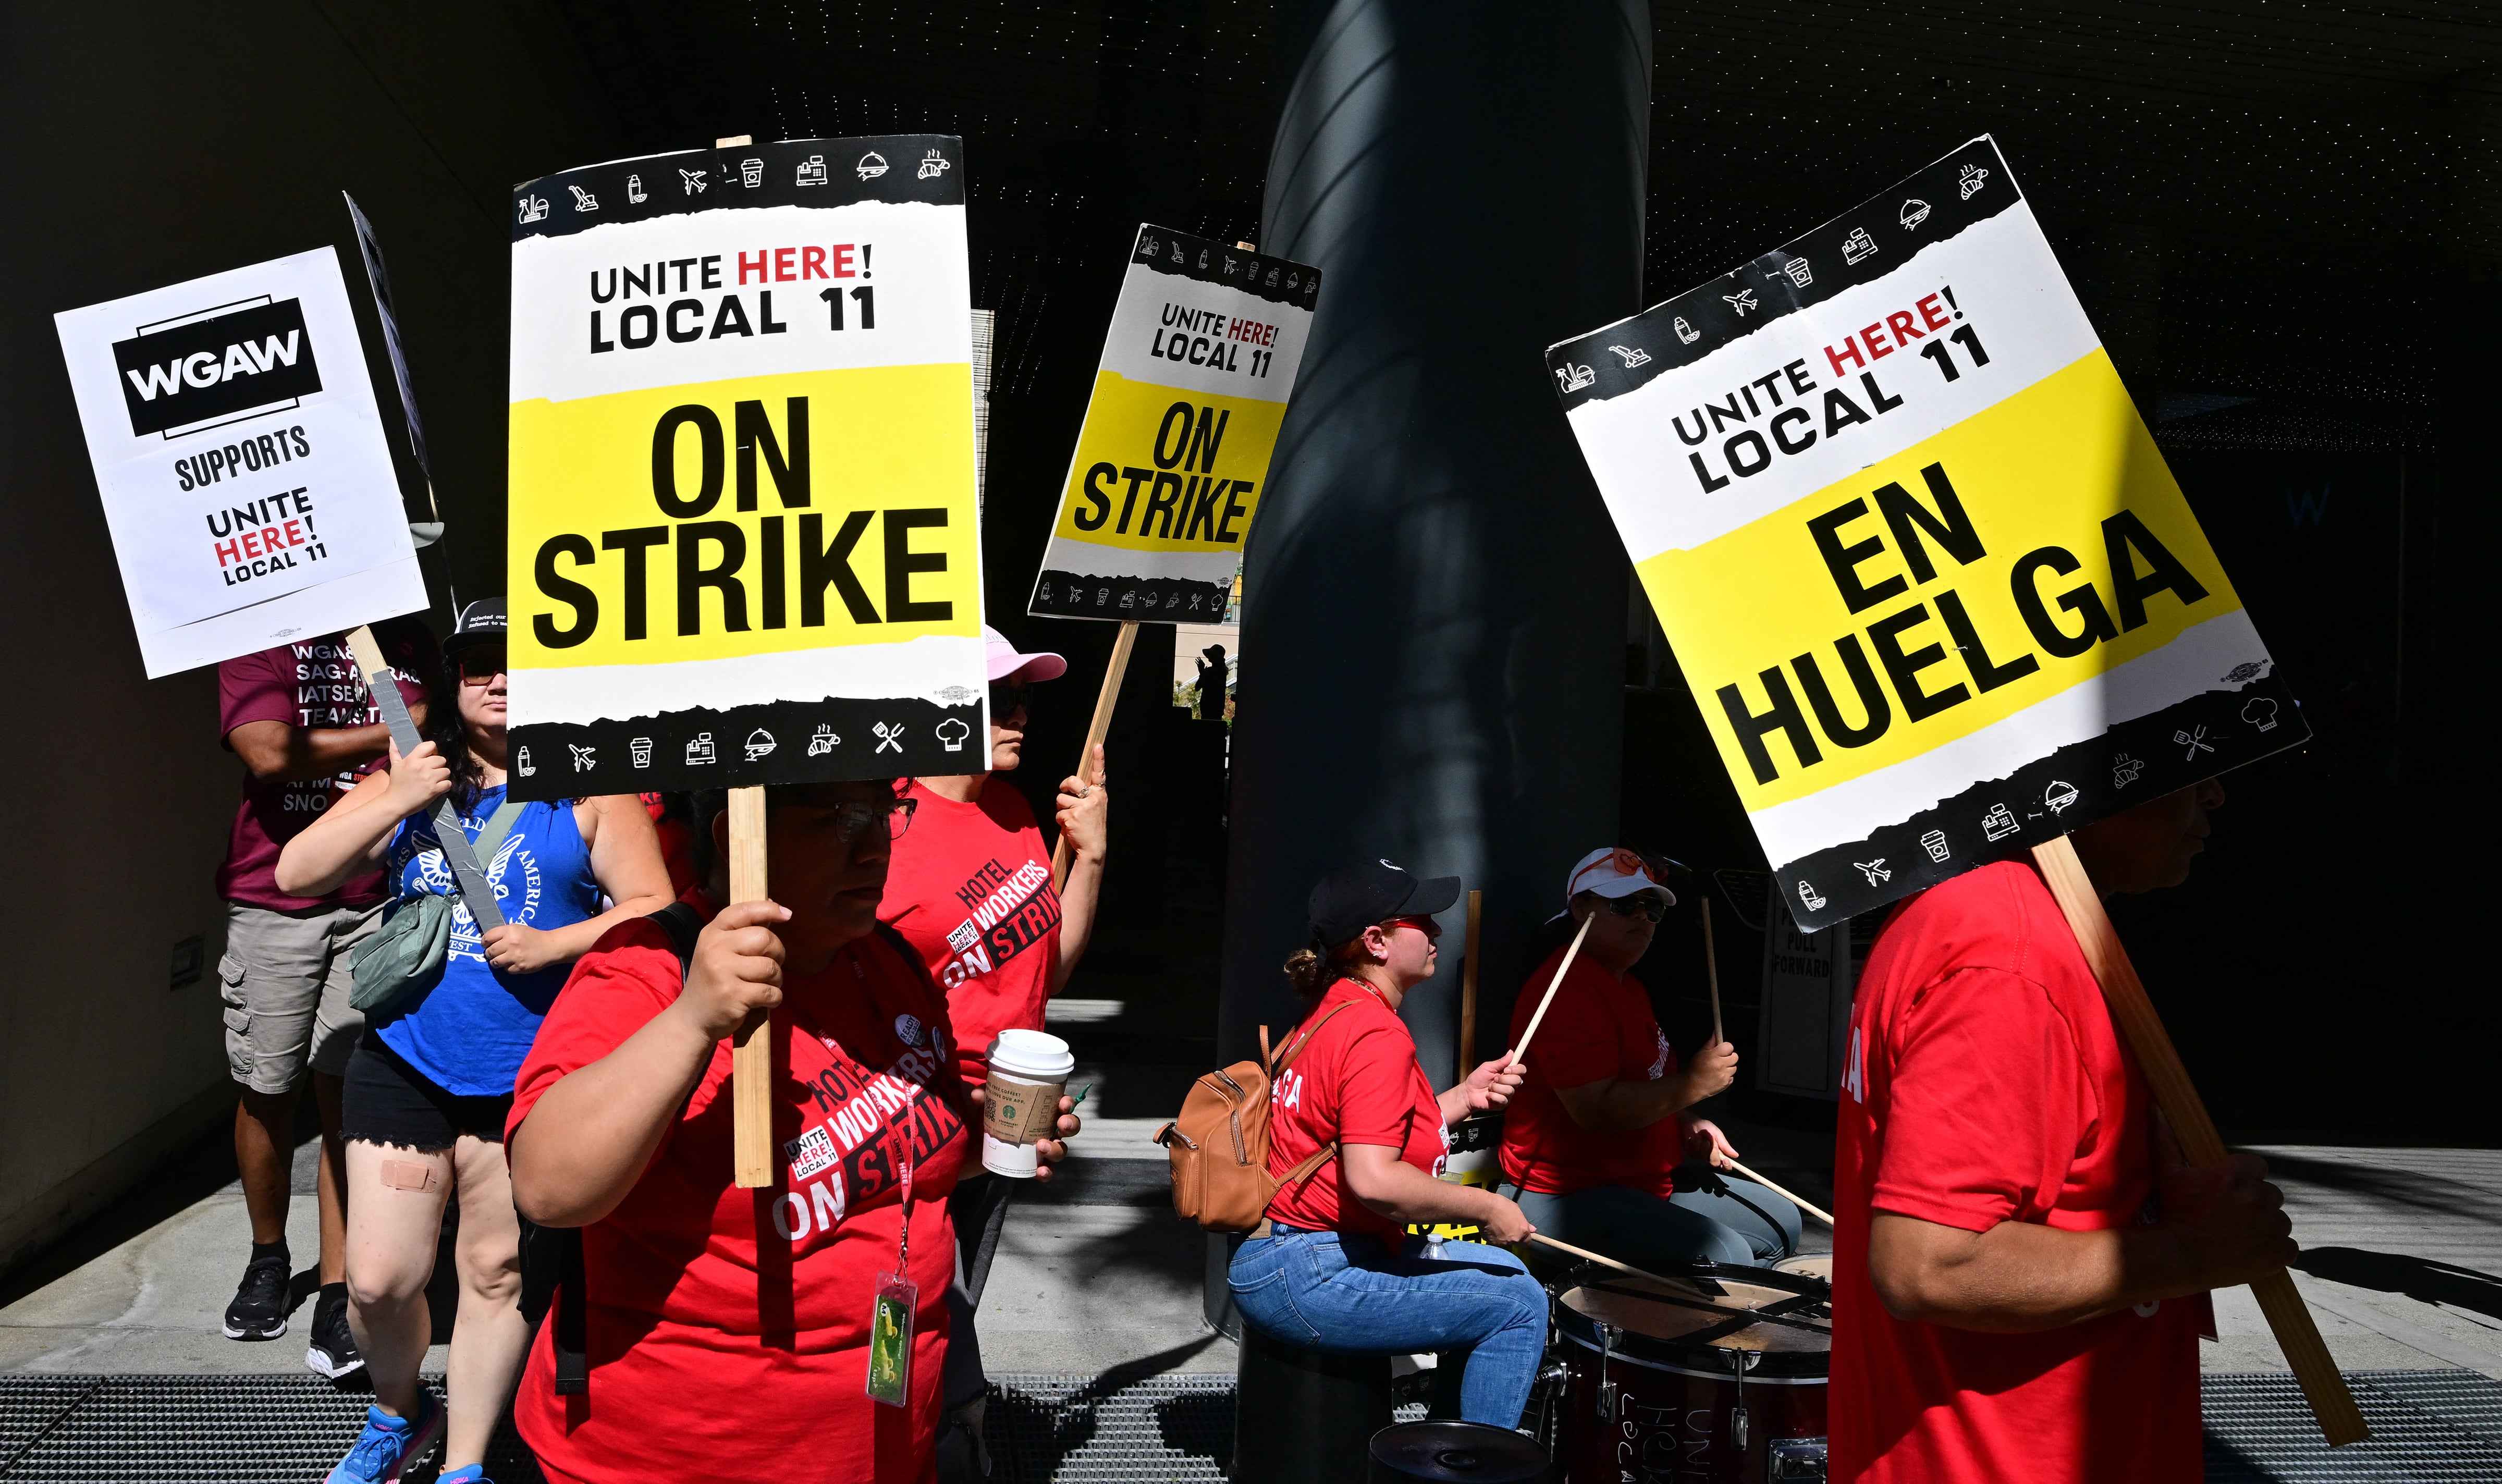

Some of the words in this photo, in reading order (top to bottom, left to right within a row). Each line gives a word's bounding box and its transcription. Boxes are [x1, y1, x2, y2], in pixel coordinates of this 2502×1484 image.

[591, 255, 721, 304] UNITE
[738, 243, 873, 286] HERE!
[591, 290, 787, 354] LOCAL
[819, 286, 875, 332] 11
[1161, 302, 1226, 338] UNITE
[1228, 317, 1279, 349] HERE!
[127, 329, 300, 402] WGAW
[1150, 328, 1237, 372] LOCAL
[1250, 351, 1272, 378] 11
[1671, 358, 1817, 446] UNITE
[1823, 285, 1964, 378] HERE!
[1688, 372, 1904, 495] LOCAL
[1920, 323, 1990, 383] 11
[175, 425, 310, 492] SUPPORTS
[652, 396, 811, 519] ON
[1152, 401, 1230, 474] ON
[206, 486, 313, 538] UNITE
[1074, 461, 1255, 544] STRIKE
[214, 514, 318, 567] HERE!
[1806, 461, 1987, 616] EN
[223, 554, 297, 586] LOCAL
[305, 543, 327, 561] 11
[532, 508, 953, 649] STRIKE
[1715, 508, 2210, 786] HUELGA
[296, 664, 421, 684] SAG-ARA&
[339, 771, 352, 780] WGA
[517, 850, 541, 926] AMERICA
[955, 858, 1012, 910] HOTEL
[973, 859, 1048, 931] WORKERS
[449, 939, 473, 951] EST
[948, 921, 972, 943] UNITE
[952, 928, 974, 949] HERE!
[955, 940, 972, 953] LOCAL
[1788, 932, 1817, 953] PULL
[943, 945, 991, 988] ON
[1774, 954, 1829, 978] FORWARD
[900, 1015, 915, 1040] READY
[1001, 1088, 1021, 1097] COFFEE?
[786, 1129, 827, 1157] UNITE
[791, 1140, 832, 1168] HERE!
[797, 1158, 826, 1178] LOCAL
[828, 1152, 837, 1161] 11
[893, 1137, 905, 1163] UNITE
[899, 1162, 909, 1187] HERE!
[772, 1171, 845, 1241] ON
[881, 1305, 887, 1315] M
[375, 1422, 393, 1431] HOKA
